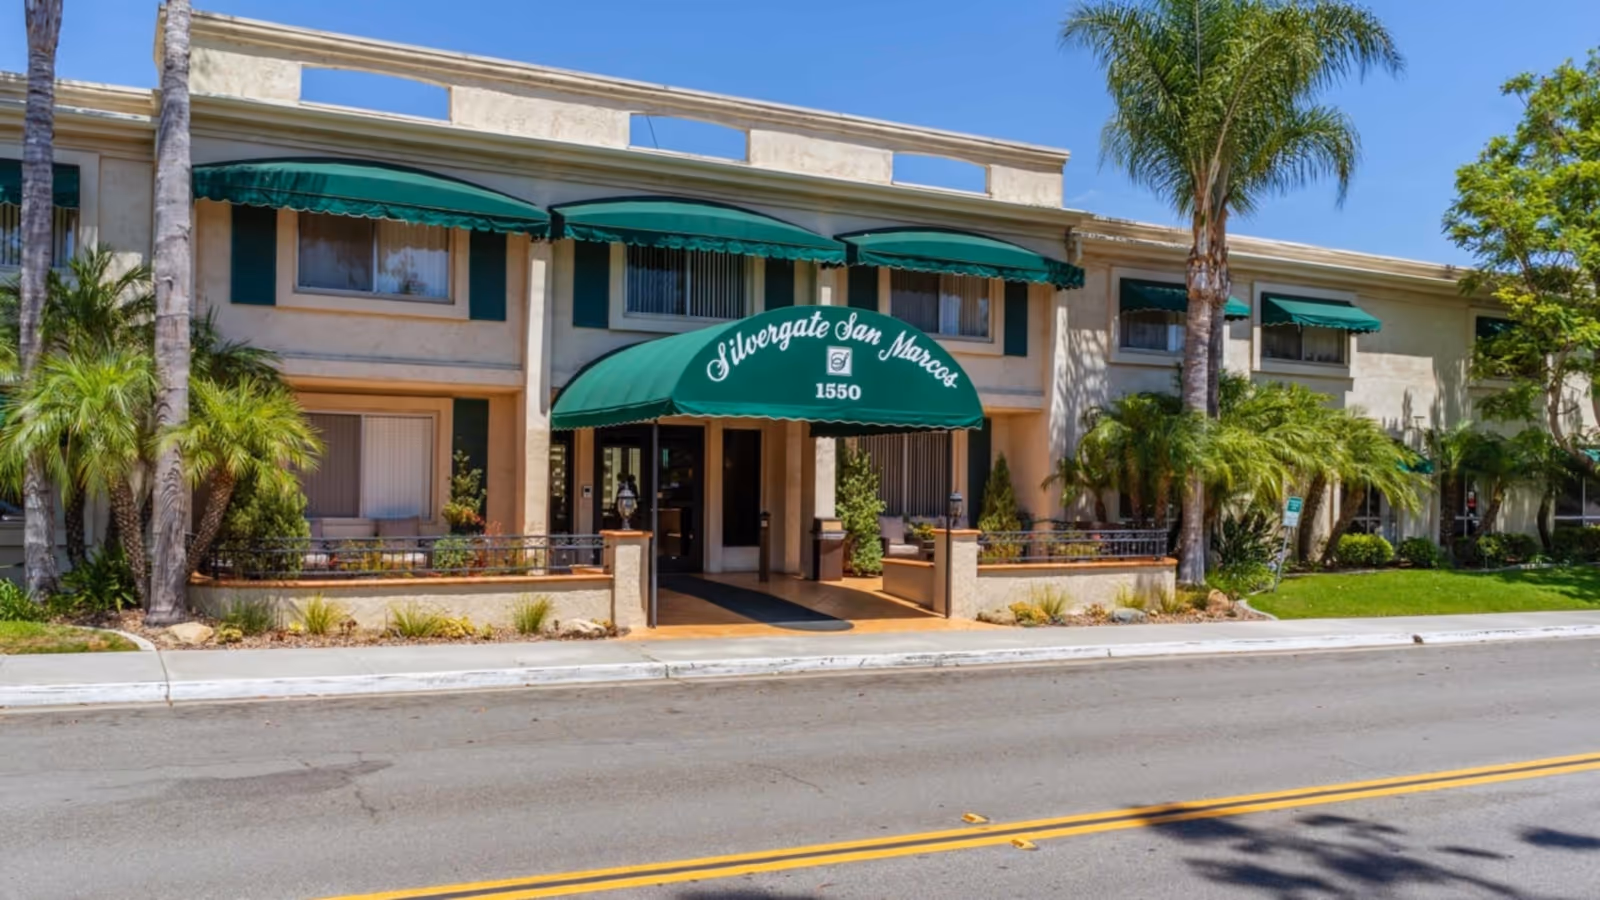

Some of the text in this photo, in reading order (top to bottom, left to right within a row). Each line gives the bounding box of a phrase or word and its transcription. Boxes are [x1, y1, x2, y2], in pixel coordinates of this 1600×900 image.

[706, 311, 957, 388] Silvergate San Marcos
[815, 383, 861, 400] 1550
